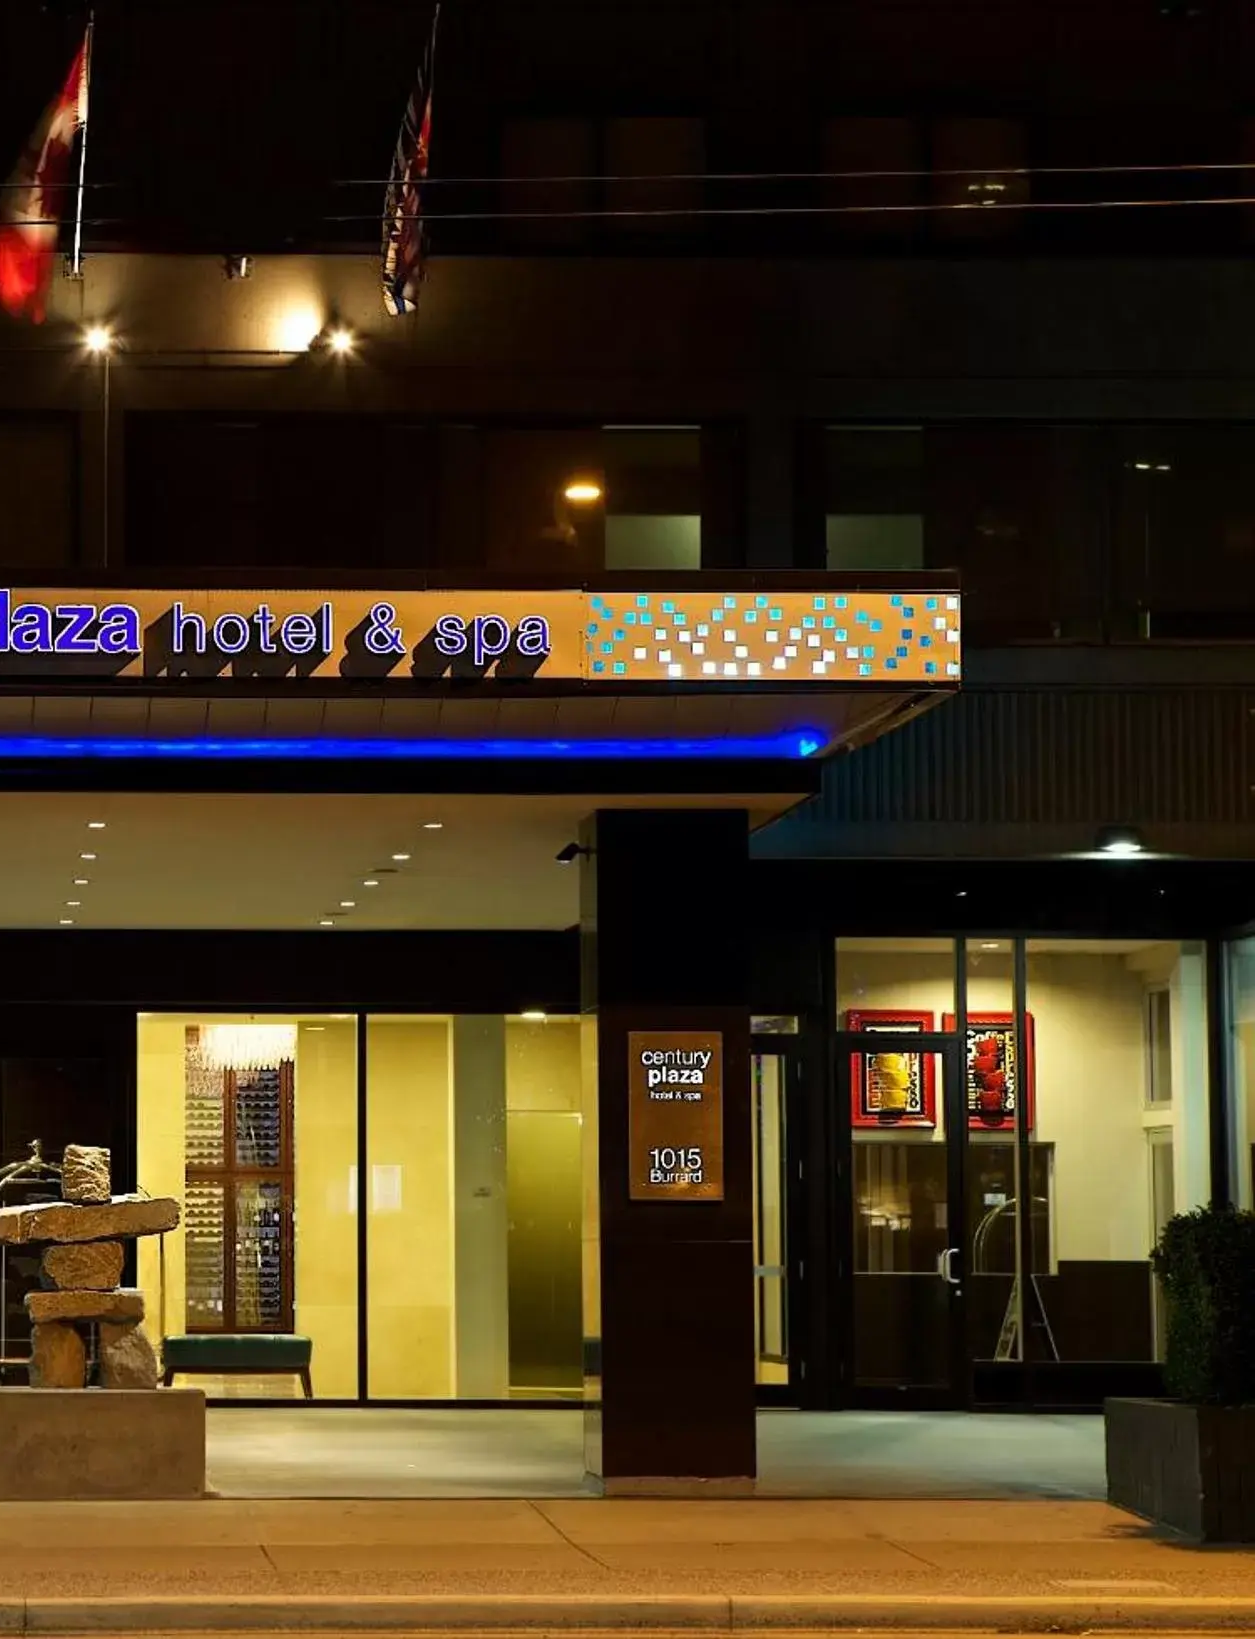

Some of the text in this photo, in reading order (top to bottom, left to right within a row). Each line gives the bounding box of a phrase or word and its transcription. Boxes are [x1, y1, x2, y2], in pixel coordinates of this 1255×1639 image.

[171, 601, 334, 656] hotel
[364, 603, 406, 656] &
[434, 614, 552, 666] spa
[641, 1048, 712, 1069] century
[648, 1066, 704, 1087] plaza
[650, 1148, 702, 1169] 1015
[650, 1168, 702, 1183] Burrard
